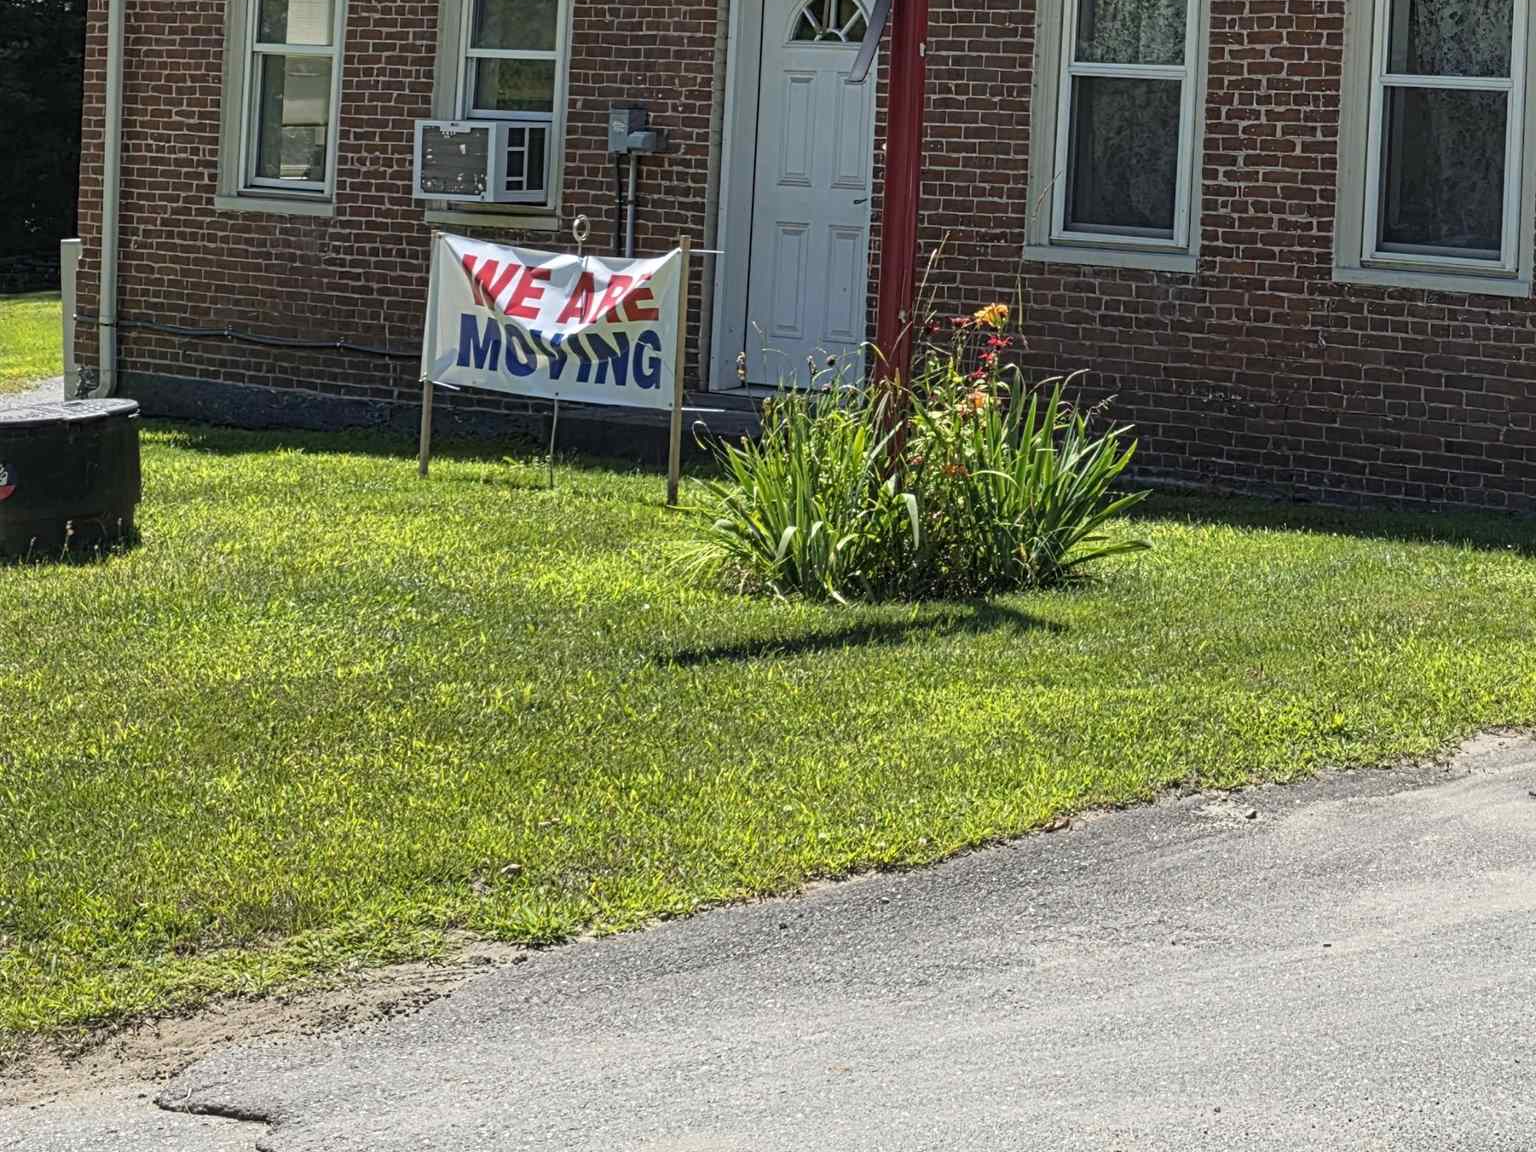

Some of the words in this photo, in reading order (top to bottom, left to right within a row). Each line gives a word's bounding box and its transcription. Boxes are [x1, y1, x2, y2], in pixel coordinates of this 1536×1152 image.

[461, 253, 552, 320] WE
[556, 271, 660, 324] ARE
[456, 313, 662, 389] MOVING
